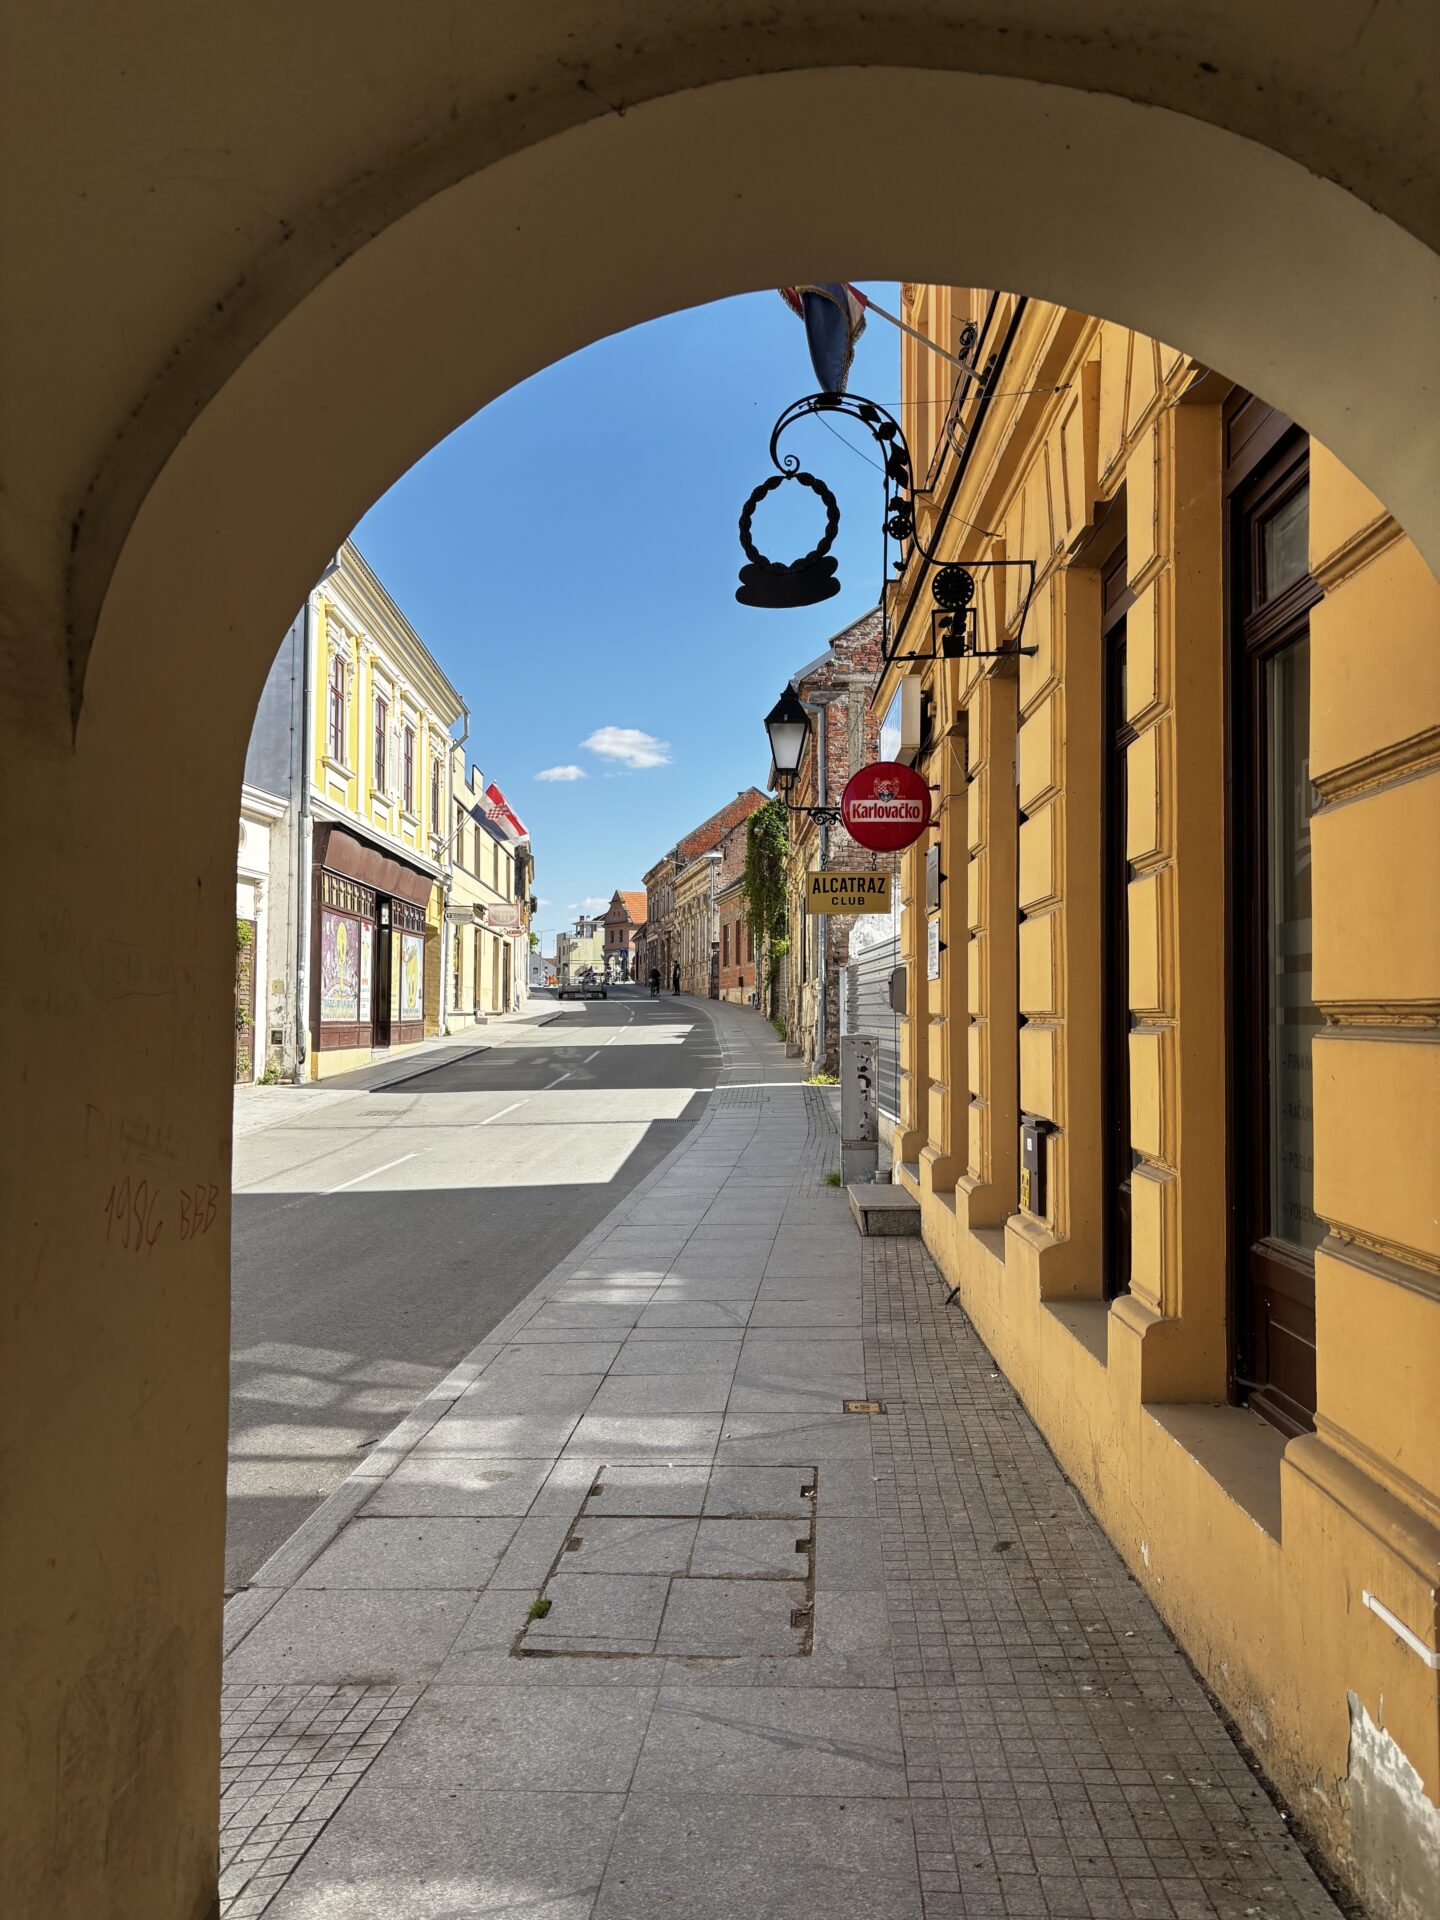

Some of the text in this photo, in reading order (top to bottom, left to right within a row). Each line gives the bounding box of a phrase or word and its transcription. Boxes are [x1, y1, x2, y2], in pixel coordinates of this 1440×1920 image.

[852, 803, 920, 819] Karlovačko
[812, 877, 886, 895] ALCATRAZ
[831, 896, 866, 906] CLUB
